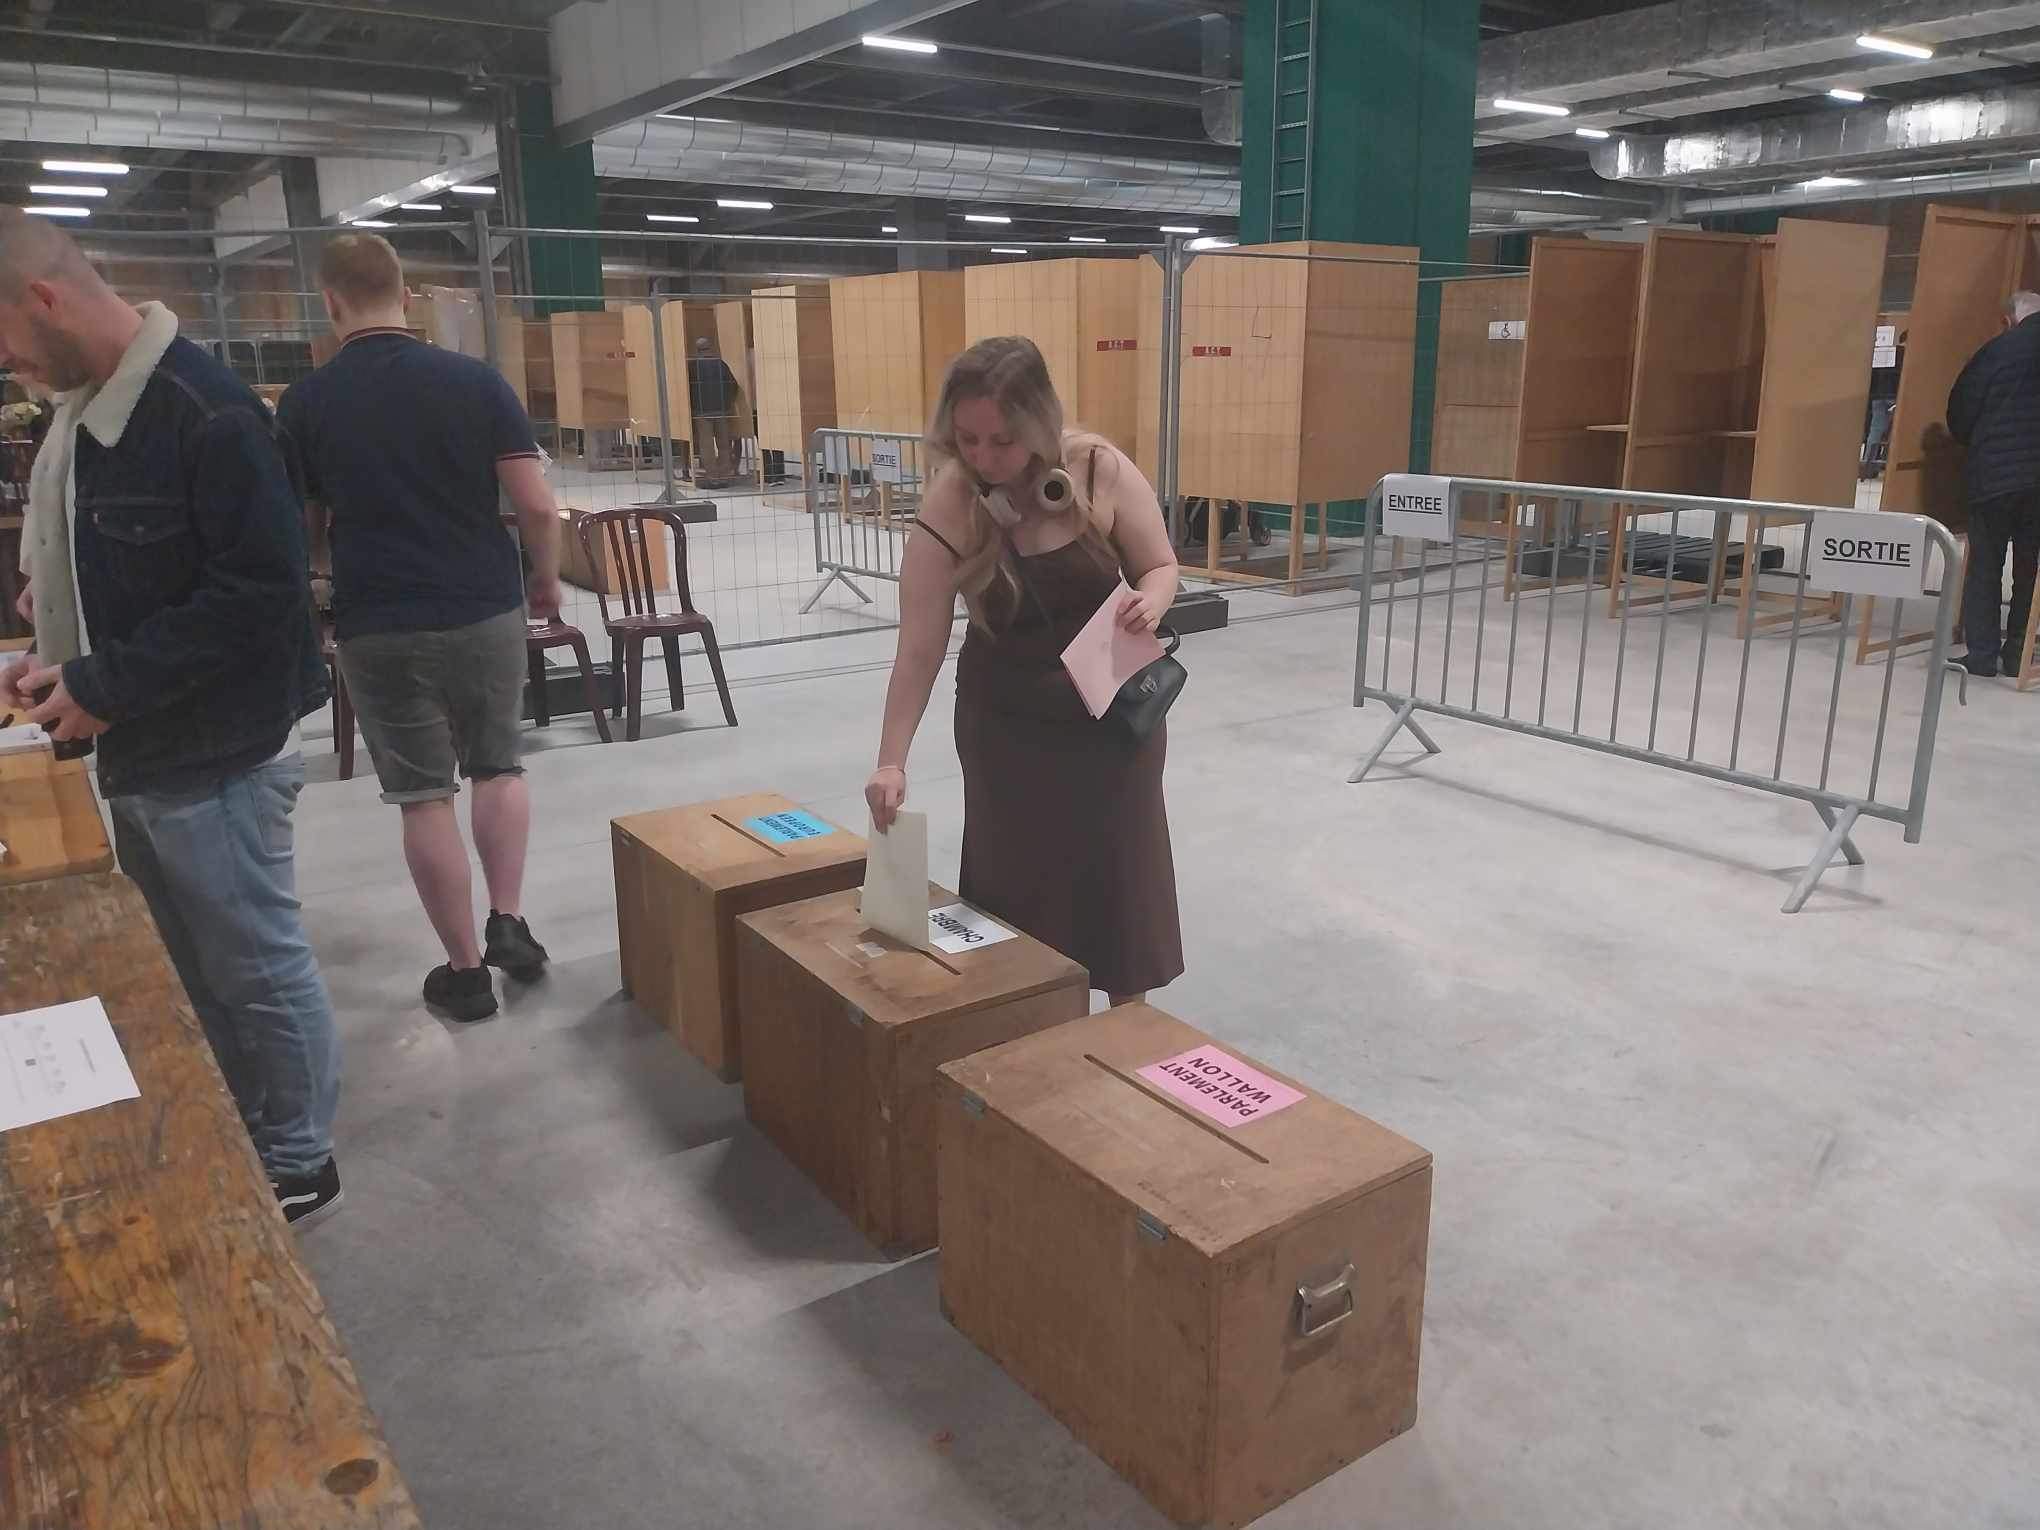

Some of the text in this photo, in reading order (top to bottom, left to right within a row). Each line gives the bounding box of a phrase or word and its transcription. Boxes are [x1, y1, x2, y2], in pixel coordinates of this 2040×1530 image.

[1387, 494, 1442, 512] ENTREE
[1823, 538, 1911, 563] SORTIE
[928, 912, 984, 943] CHAMBRE
[1158, 1062, 1259, 1117] PARLEMENT
[1187, 1057, 1273, 1104] WALLON
